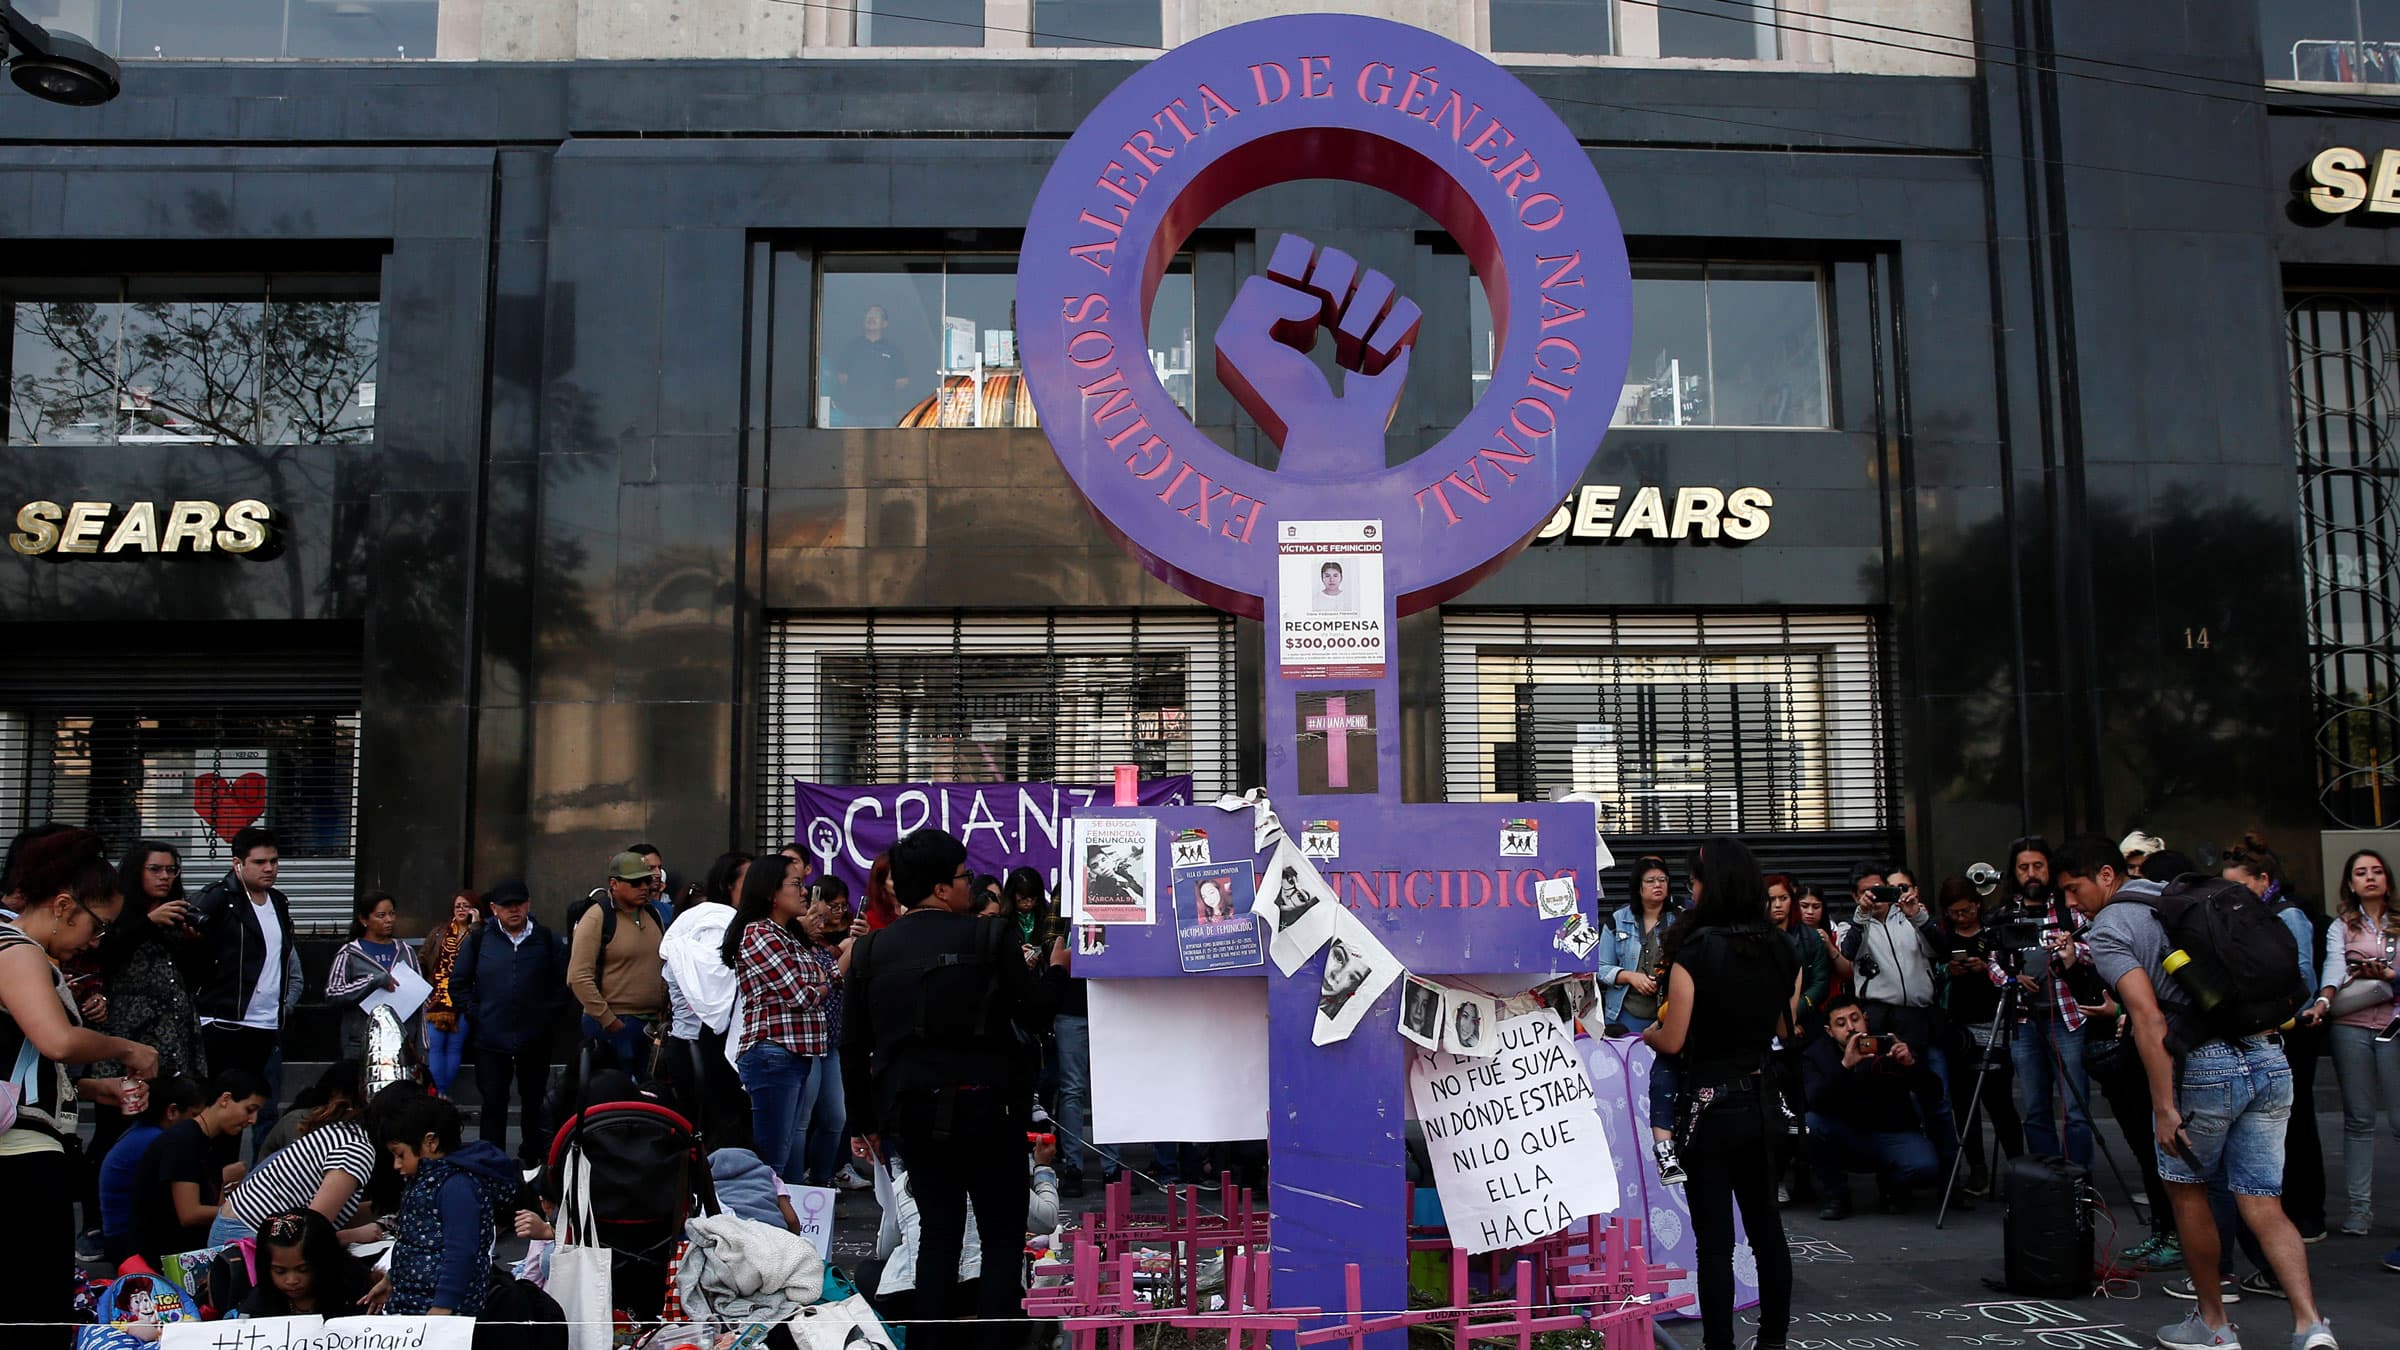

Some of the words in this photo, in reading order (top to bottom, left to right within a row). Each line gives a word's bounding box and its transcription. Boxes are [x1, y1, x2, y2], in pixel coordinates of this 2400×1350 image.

[1247, 54, 1335, 108] DE
[1356, 65, 1566, 234] GÉNERO
[1068, 82, 1241, 276] ALERTA
[1414, 248, 1588, 527] NACIONAL
[1062, 294, 1267, 545] EXIGIMOS
[9, 499, 271, 555] SEARS
[1280, 543, 1315, 554] VÍCTIMA
[1317, 544, 1329, 552] DE
[1330, 543, 1382, 553] FEMINICIDIO
[1285, 620, 1379, 632] RECOMPENSA
[2184, 627, 2211, 650] 14
[1285, 637, 1380, 651] $300,000.00
[1576, 656, 1721, 680] VERSACE
[1328, 716, 1345, 728] UNA
[1345, 715, 1368, 728] MENOS
[1091, 820, 1105, 828] SE
[1108, 820, 1137, 828] BUSCA
[1086, 836, 1146, 844] DENUNCIALO
[1180, 926, 1204, 938] VÍCTIMA
[1206, 926, 1214, 935] DE
[1431, 1076, 1461, 1102] NO
[1468, 1057, 1505, 1091] FUÉ
[1512, 1045, 1576, 1080] SUYA,
[1425, 1117, 1448, 1142] NI
[1453, 1096, 1518, 1135] DÓNDE
[1453, 1147, 1478, 1173] NI
[1481, 1138, 1509, 1165] LO
[1521, 1120, 1575, 1155] QUE
[1486, 1165, 1552, 1202] ELLA
[1481, 1194, 1574, 1246] HACÍA
[154, 1294, 179, 1306] TOY
[1912, 1308, 1972, 1322] se
[1978, 1300, 2089, 1326] NO
[2036, 1327, 2144, 1350] NO
